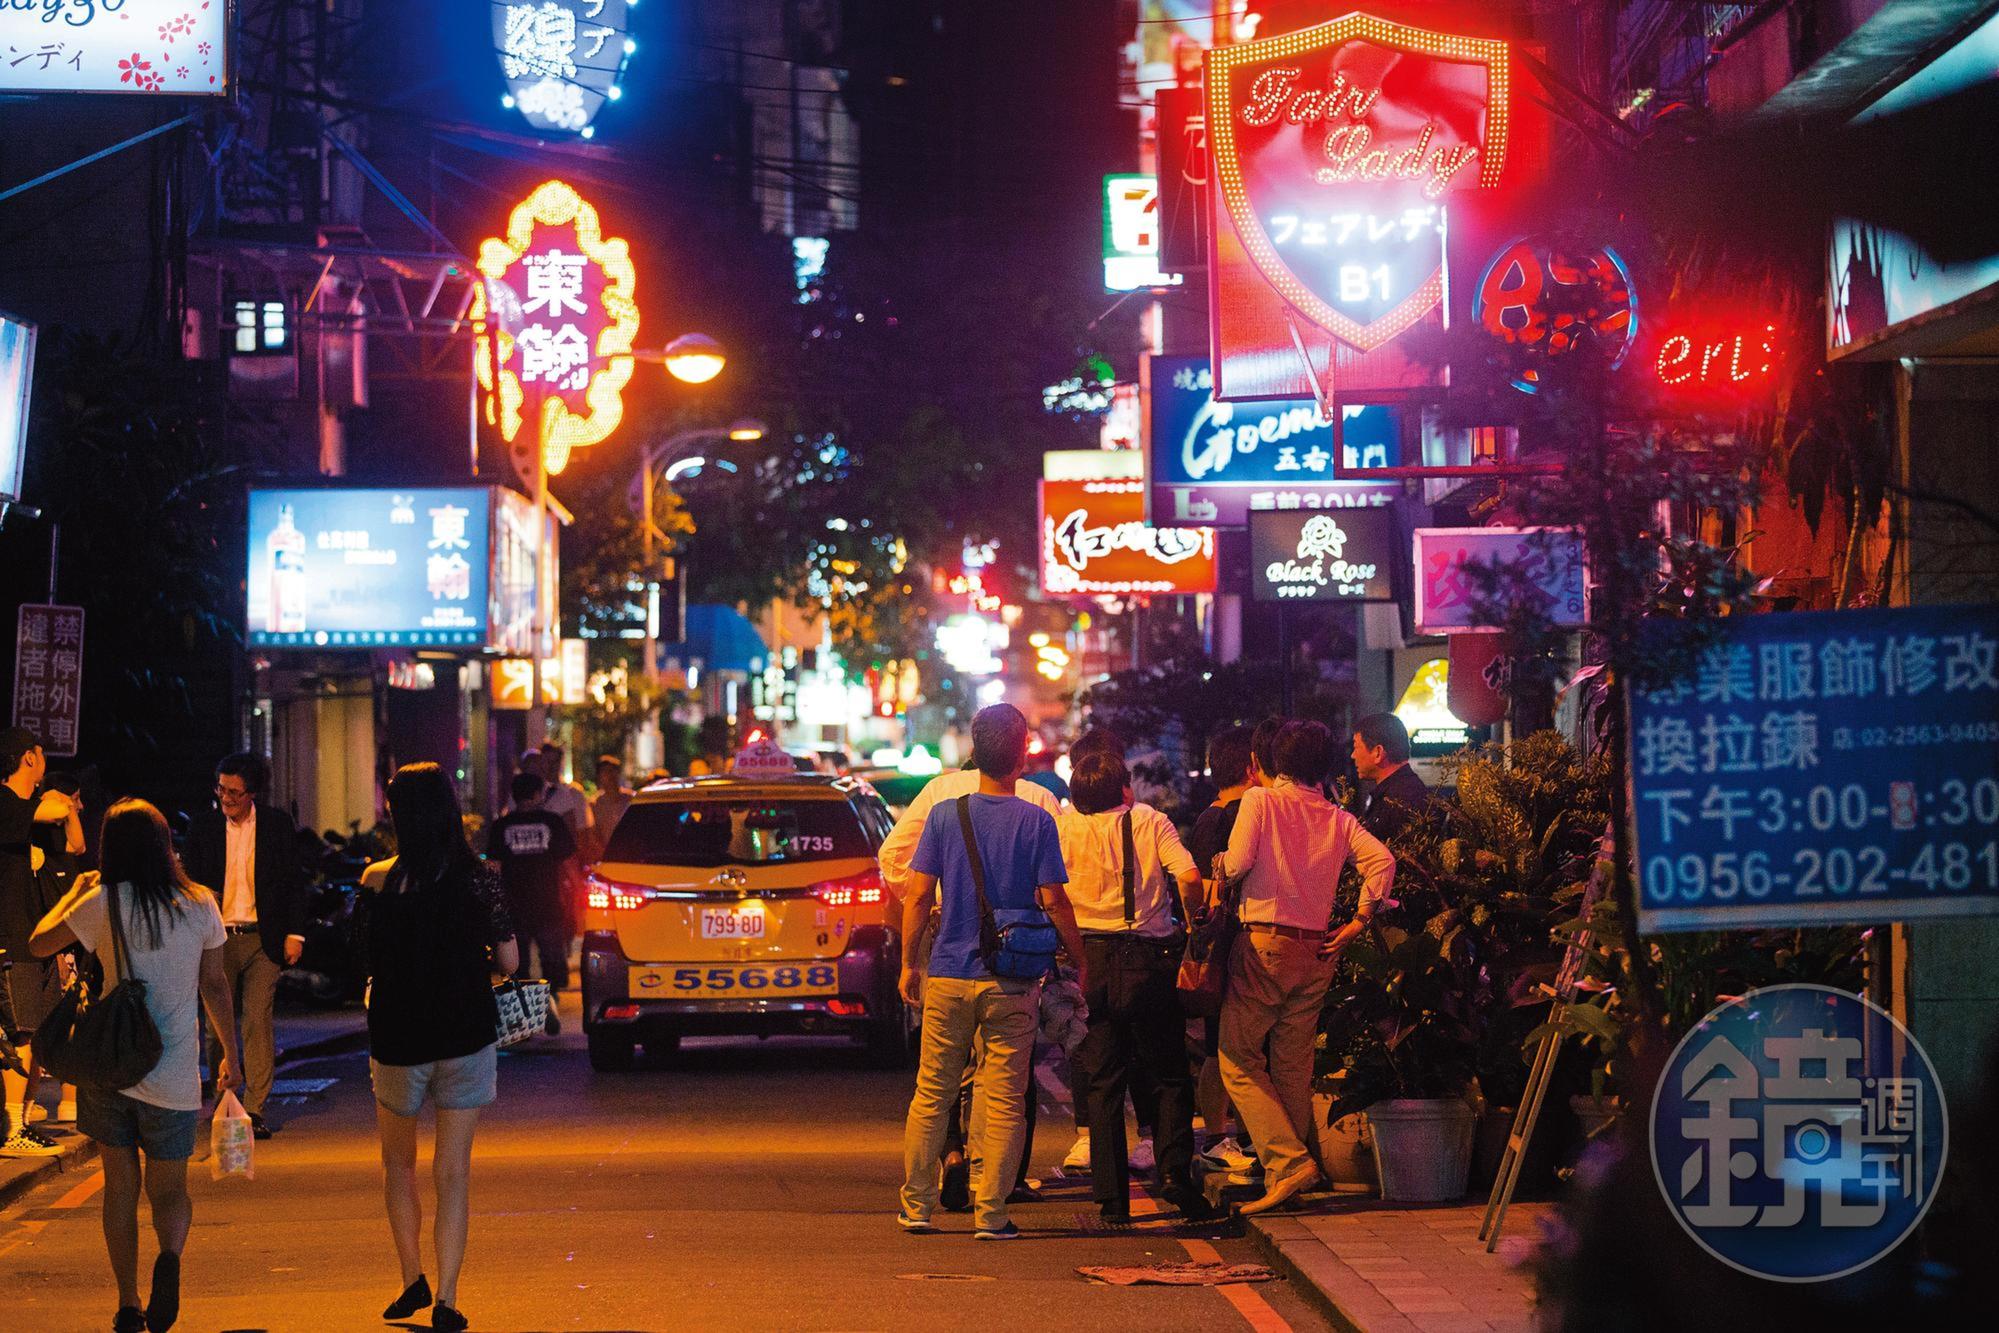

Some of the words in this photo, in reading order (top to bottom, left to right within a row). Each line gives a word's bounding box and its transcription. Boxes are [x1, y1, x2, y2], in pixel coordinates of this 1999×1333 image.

[1243, 67, 1382, 126] Fair
[1316, 120, 1480, 197] Lady
[1339, 262, 1392, 303] B1
[1265, 559, 1328, 586] Black
[1329, 560, 1377, 583] Rose
[790, 836, 834, 851] 1735
[673, 966, 836, 990] 55688
